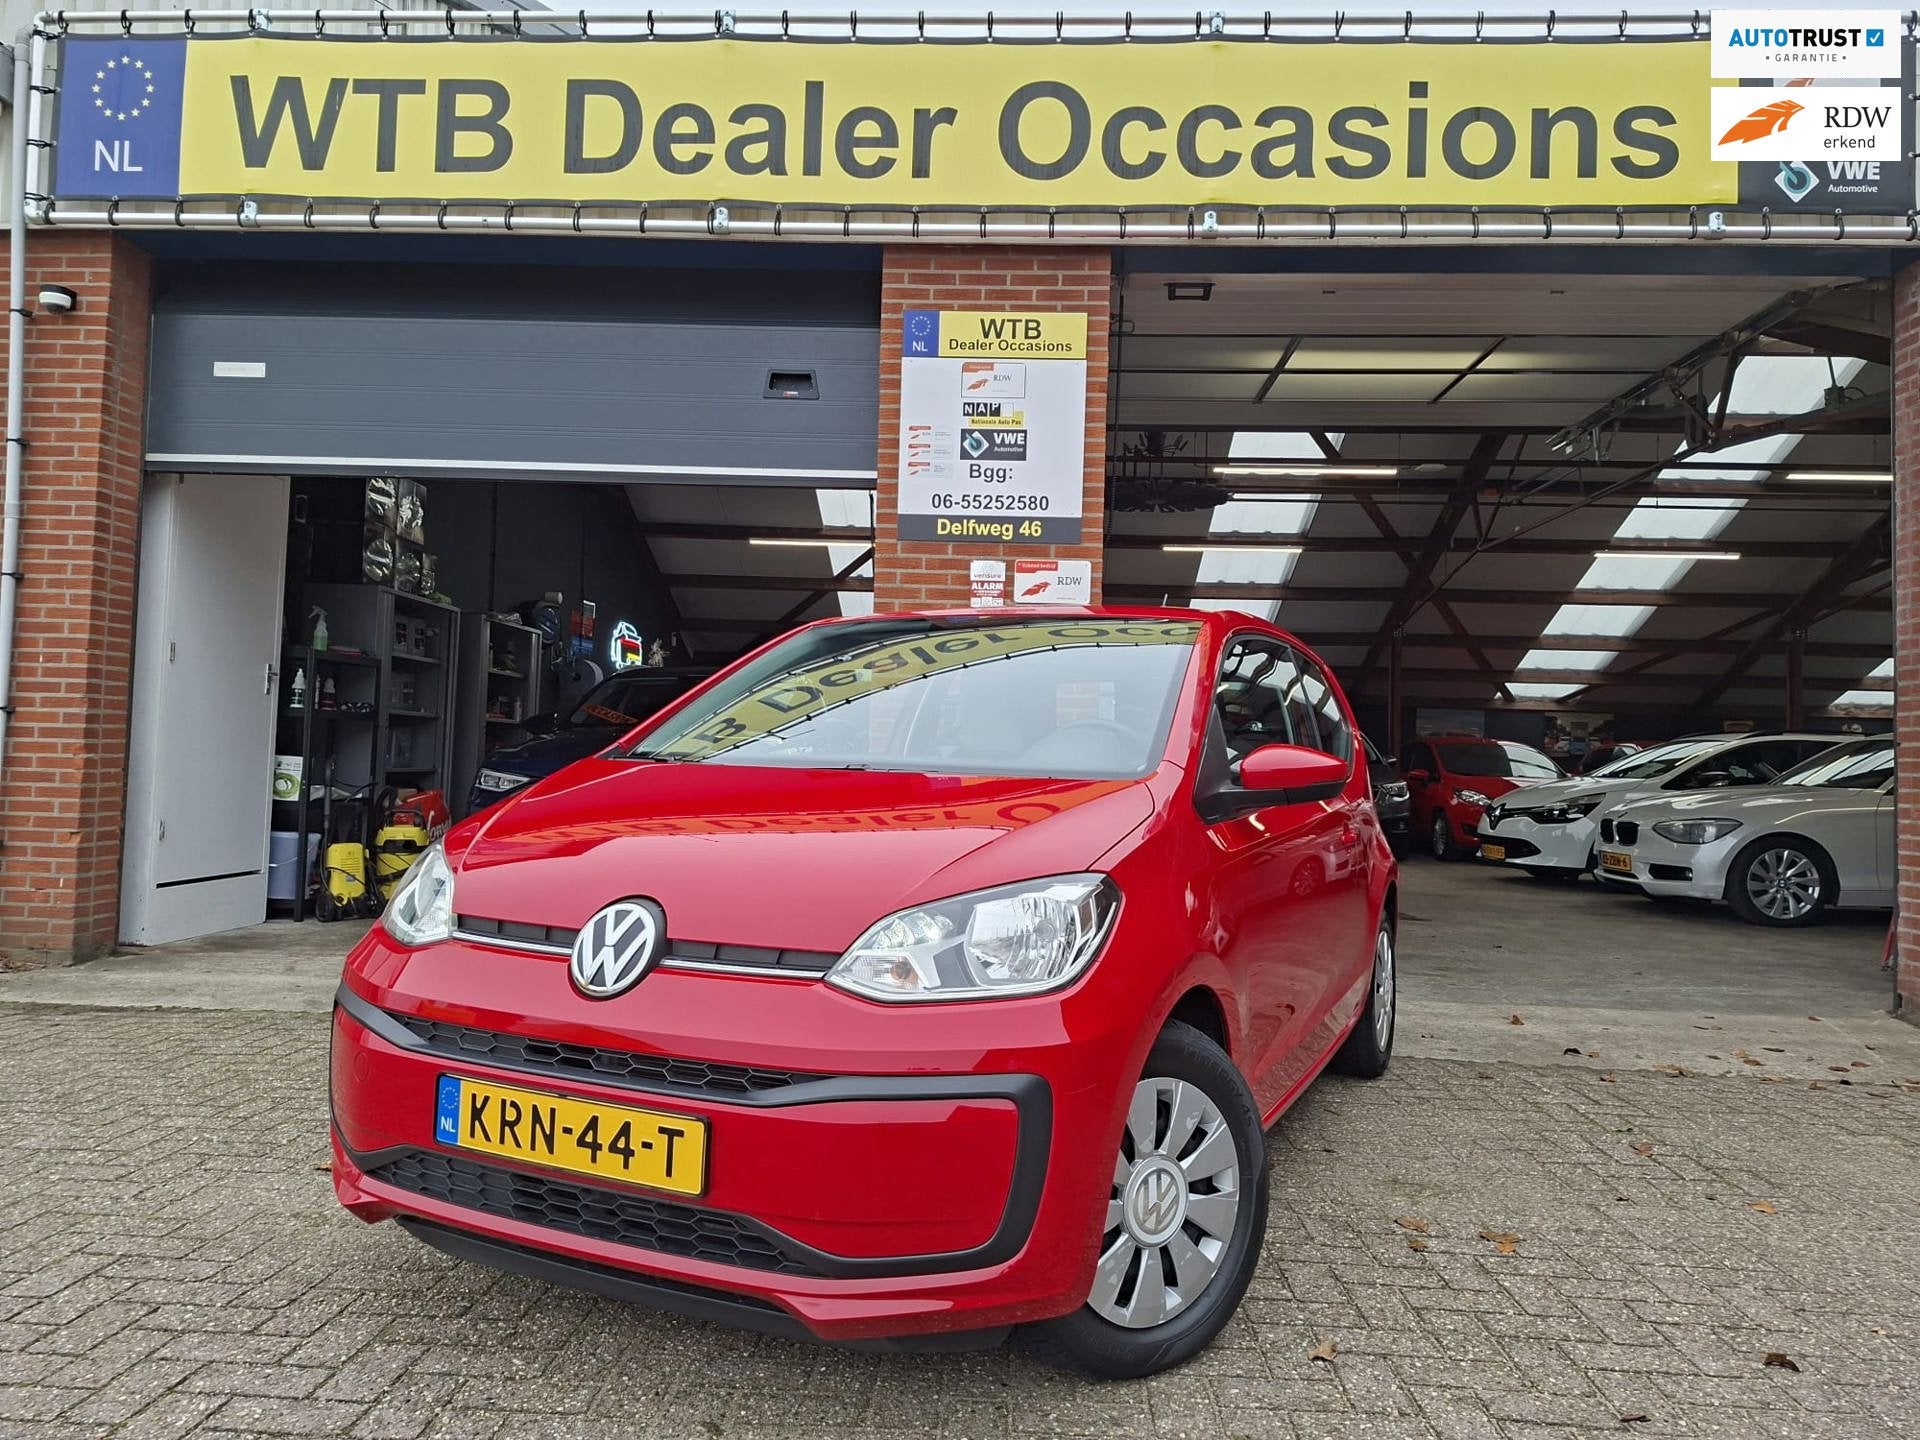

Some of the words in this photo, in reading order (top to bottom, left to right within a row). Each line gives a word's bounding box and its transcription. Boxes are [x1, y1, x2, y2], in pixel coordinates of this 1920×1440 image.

[229, 74, 514, 175] WTB
[563, 78, 958, 179] Dealer
[998, 80, 1679, 181] Occasions
[94, 140, 143, 173] NL
[1827, 161, 1880, 180] VWE
[1828, 184, 1878, 193] Automotive
[980, 318, 1042, 340] WTB
[912, 340, 928, 352] NL
[949, 338, 994, 351] Dealer
[998, 339, 1073, 352] Occasions
[993, 432, 1025, 445] VWE
[969, 463, 1013, 483] Bgg:
[931, 493, 1049, 511] 06-55252580
[937, 518, 1014, 540] Delfweg
[1019, 520, 1042, 537] 46
[971, 582, 1004, 591] ALARM
[1057, 576, 1082, 586] RDW
[440, 1116, 456, 1133] NL
[469, 1092, 685, 1178] KRN-44-T
